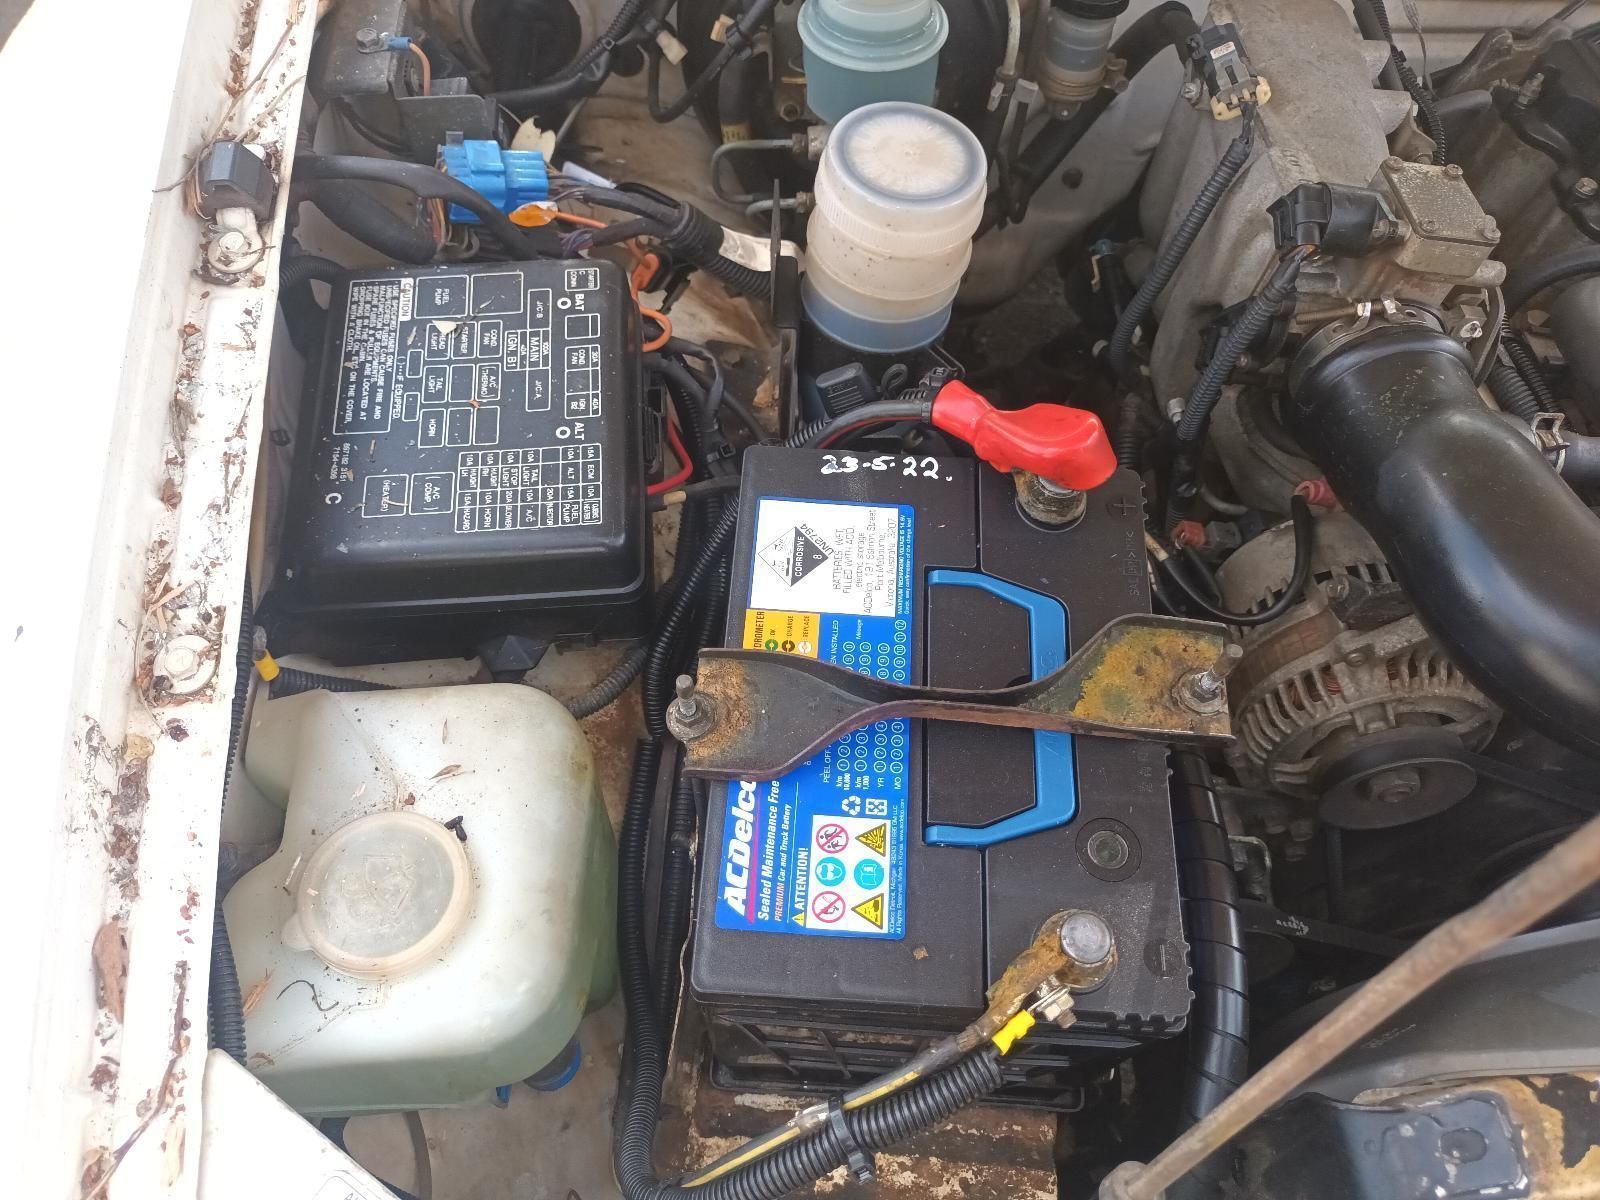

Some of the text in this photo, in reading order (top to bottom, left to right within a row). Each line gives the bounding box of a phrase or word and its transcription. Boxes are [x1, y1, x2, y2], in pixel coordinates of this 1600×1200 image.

[402, 282, 412, 317] CAUTION
[575, 293, 584, 311] BAT
[375, 331, 382, 339] OF
[379, 349, 387, 362] CAN
[507, 334, 517, 367] IGN. B1
[530, 337, 539, 361] MAIN
[350, 372, 357, 381] ON
[377, 365, 385, 386] CAUSE
[361, 379, 370, 408] LOCATED
[360, 411, 366, 420] AT
[374, 406, 382, 419] AND
[571, 401, 577, 409] B2
[428, 419, 436, 436] HORN
[575, 422, 584, 440] ALT
[523, 467, 531, 486] LIGHT
[325, 493, 342, 504] C
[867, 510, 875, 531] Street
[799, 523, 834, 556] UN2794
[857, 533, 866, 559] storage
[794, 536, 805, 577] CORROSIVE
[843, 570, 852, 593] FILLED
[753, 611, 764, 648] DROMETER
[830, 620, 838, 653] INSTALLED
[823, 765, 831, 783] PEEL
[878, 778, 884, 787] YR
[895, 777, 901, 789] MO
[782, 804, 792, 829] Battery
[723, 781, 757, 916] ACDelco
[757, 780, 780, 920] Sealed Maintenance Free
[780, 832, 789, 850] Truck
[778, 869, 786, 881] Car
[794, 848, 809, 910] ATTENTION!
[774, 883, 784, 921] PREMIUM
